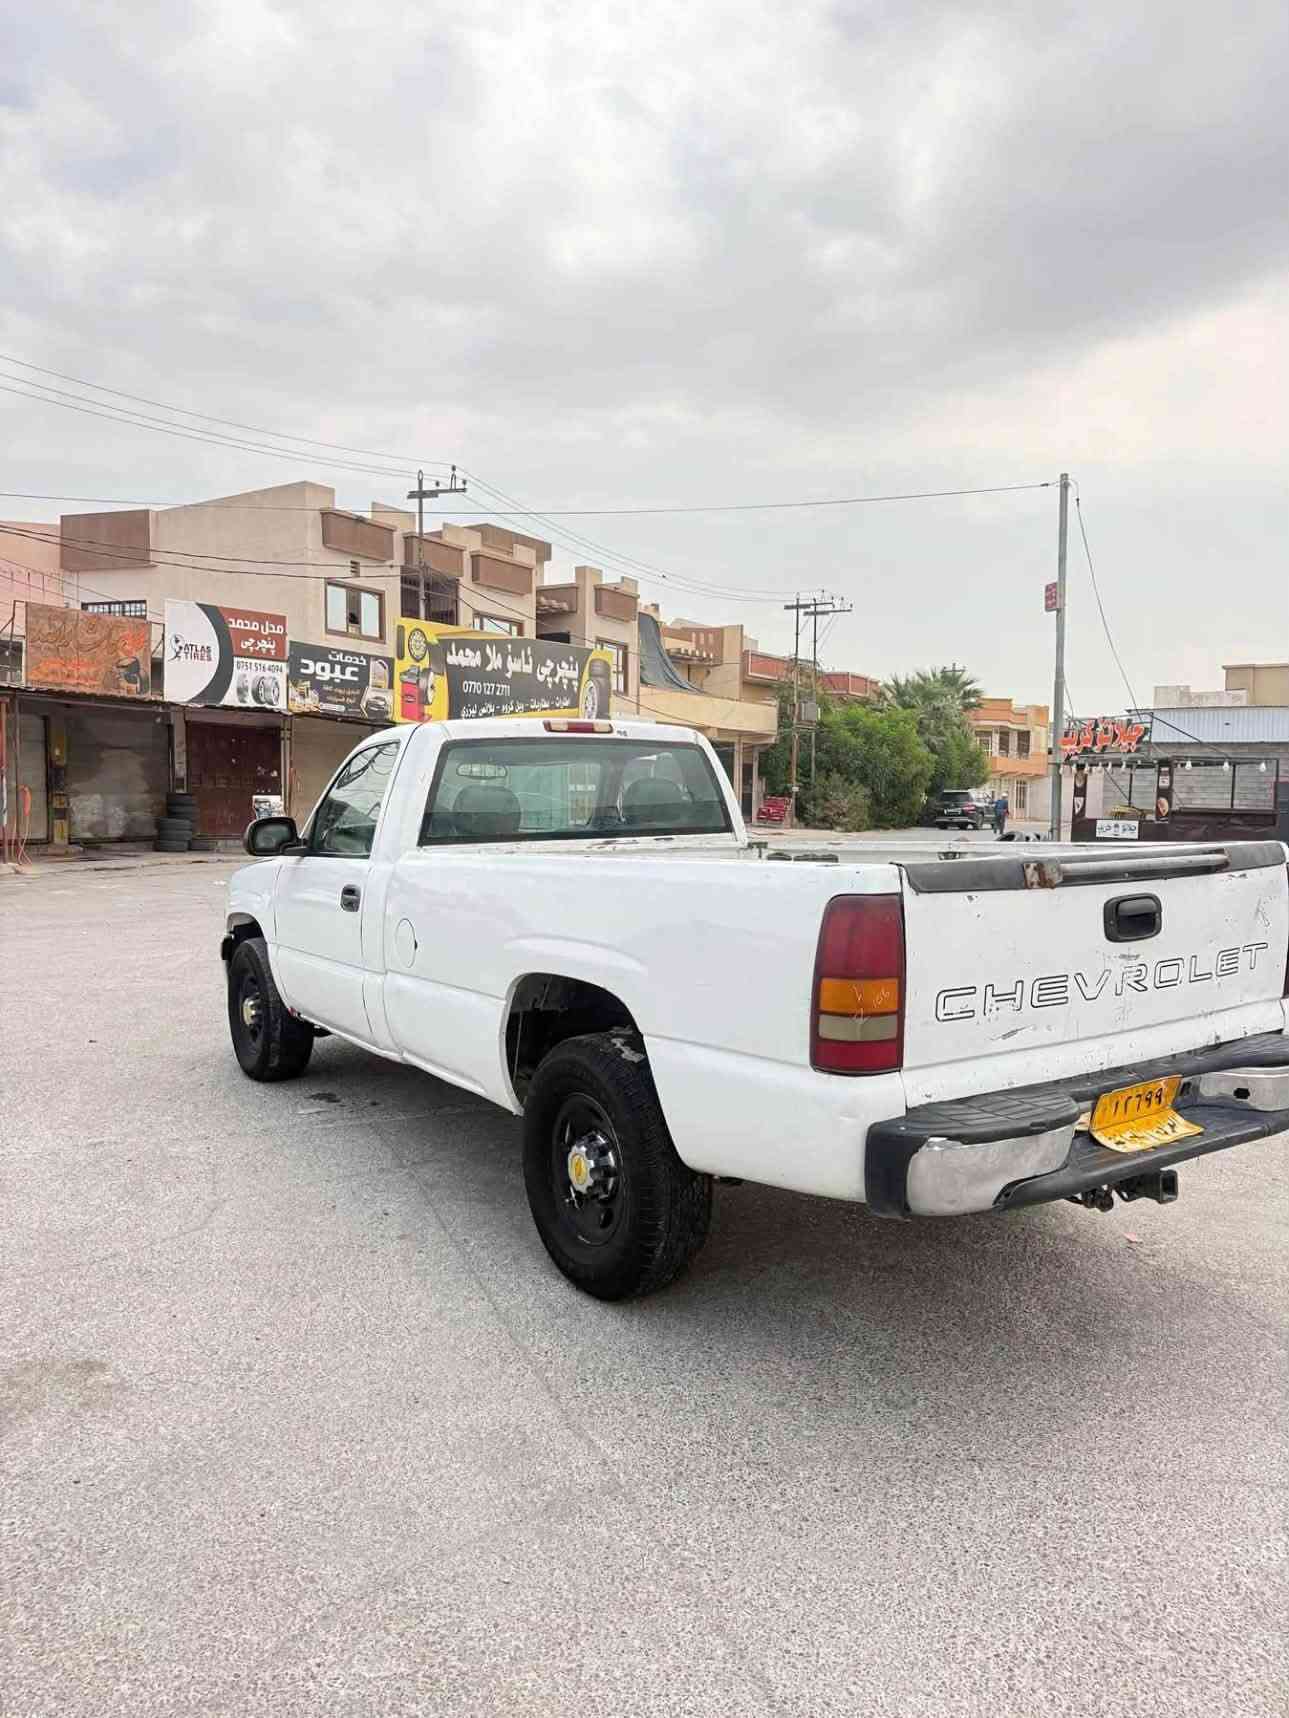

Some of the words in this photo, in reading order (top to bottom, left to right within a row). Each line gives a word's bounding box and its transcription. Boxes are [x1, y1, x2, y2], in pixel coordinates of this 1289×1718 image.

[228, 618, 259, 631] محمد
[261, 621, 284, 635] محل
[183, 643, 212, 654] ATLAS
[184, 652, 212, 661] TIRES
[446, 641, 482, 669] محمد
[328, 650, 367, 666] خدمات
[485, 643, 502, 672] ملا
[300, 658, 359, 683] عبود
[462, 680, 482, 694] 0770
[483, 682, 495, 696] 127
[935, 942, 1269, 1022] CHEVROLET
